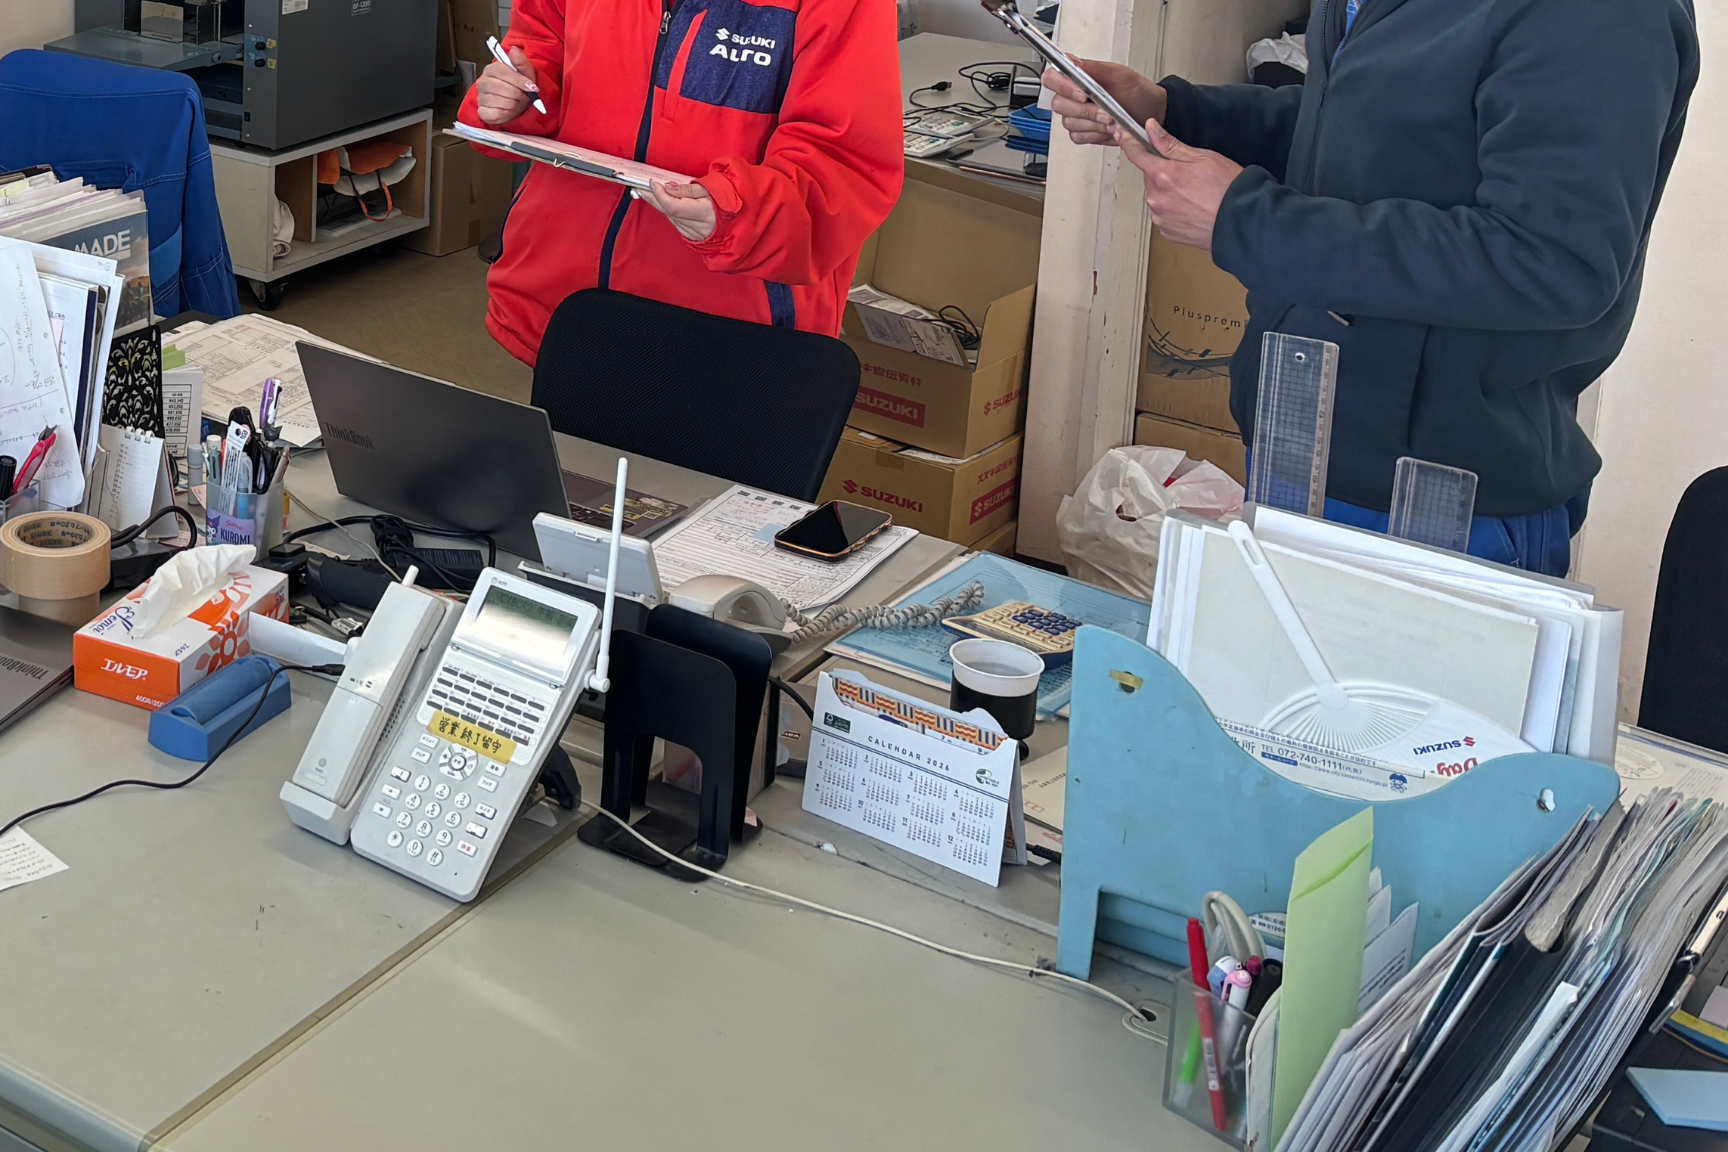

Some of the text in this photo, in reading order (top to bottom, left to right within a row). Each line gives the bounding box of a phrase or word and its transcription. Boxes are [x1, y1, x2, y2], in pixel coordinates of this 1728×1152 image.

[731, 34, 776, 49] SUZUKI
[324, 422, 374, 450] ThinkBook
[861, 486, 922, 513] SUZUKI
[984, 486, 1015, 512] SUZUKI
[221, 528, 250, 545] KUROMI
[438, 716, 502, 754] 営業終了留守
[868, 735, 950, 772] CALENDAR 2026
[1261, 744, 1275, 754] TEL
[1413, 739, 1462, 756] SUZUKI
[440, 785, 446, 793] 2
[411, 795, 417, 804] 4
[461, 794, 466, 802] 3
[430, 804, 436, 812] 5
[450, 813, 456, 821] 6
[421, 822, 427, 830] 8
[442, 832, 447, 840] 9
